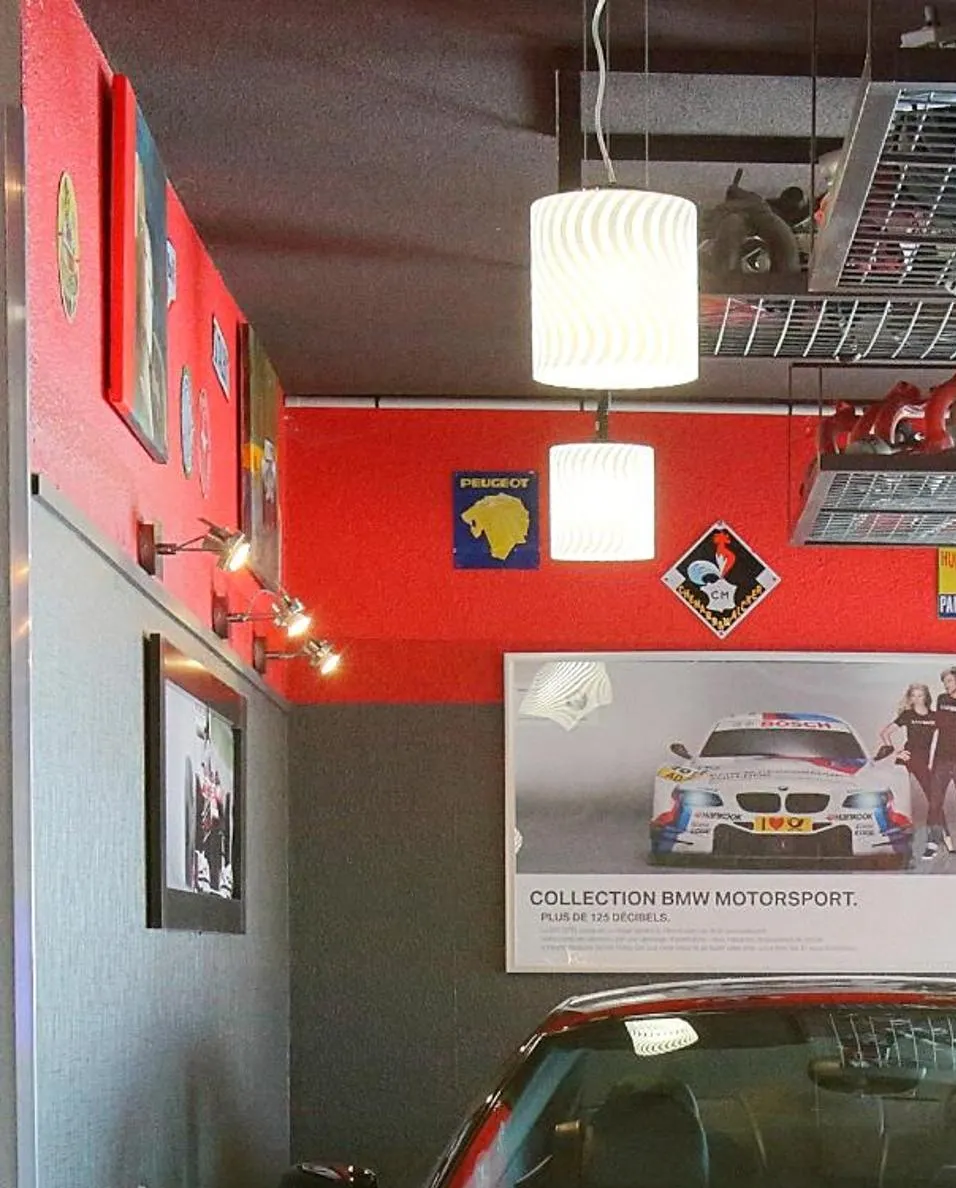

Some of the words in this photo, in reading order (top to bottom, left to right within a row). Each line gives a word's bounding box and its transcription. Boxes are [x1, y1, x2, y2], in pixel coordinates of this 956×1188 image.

[461, 478, 529, 489] PEUGEOT
[530, 890, 656, 906] COLLECTION
[661, 891, 710, 906] BMW
[715, 891, 858, 907] MOTORSPORT.
[541, 911, 570, 922] PLUS
[573, 912, 588, 922] DE
